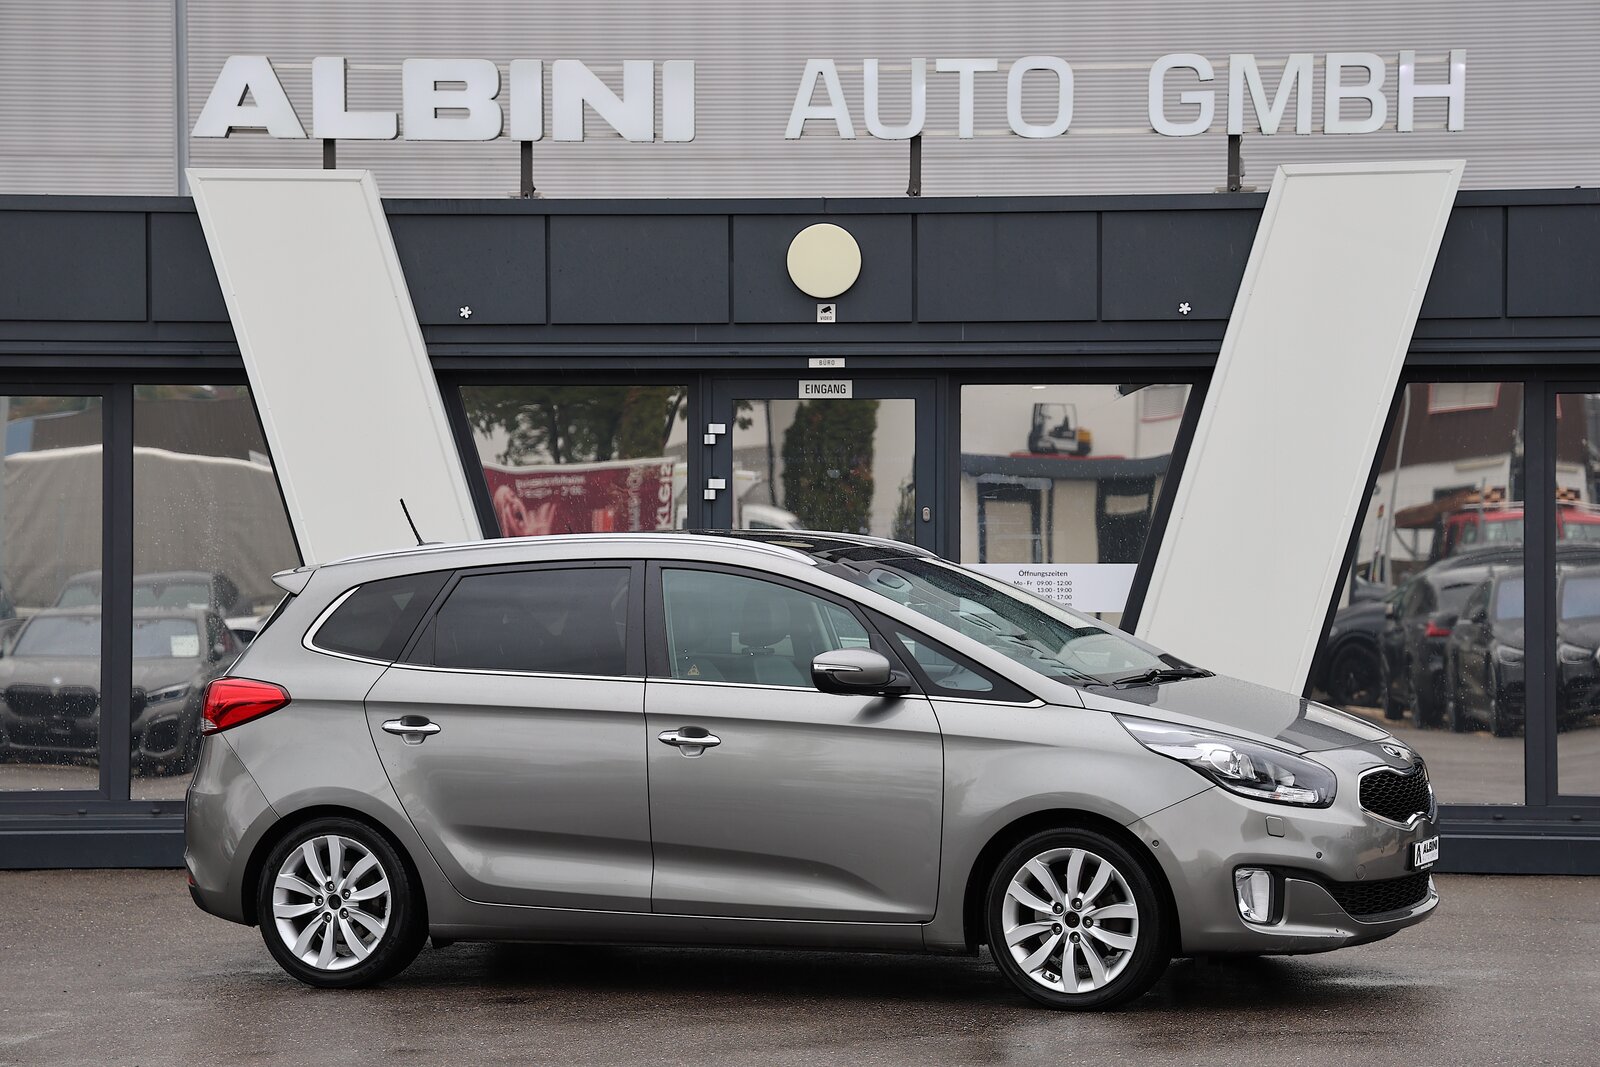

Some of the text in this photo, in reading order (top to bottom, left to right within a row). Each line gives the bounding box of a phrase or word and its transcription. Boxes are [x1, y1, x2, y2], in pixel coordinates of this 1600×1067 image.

[191, 49, 1466, 142] ALBINI AUTO GMBH
[805, 383, 847, 394] EINGANG
[1018, 569, 1068, 578] Öffnungszeiten
